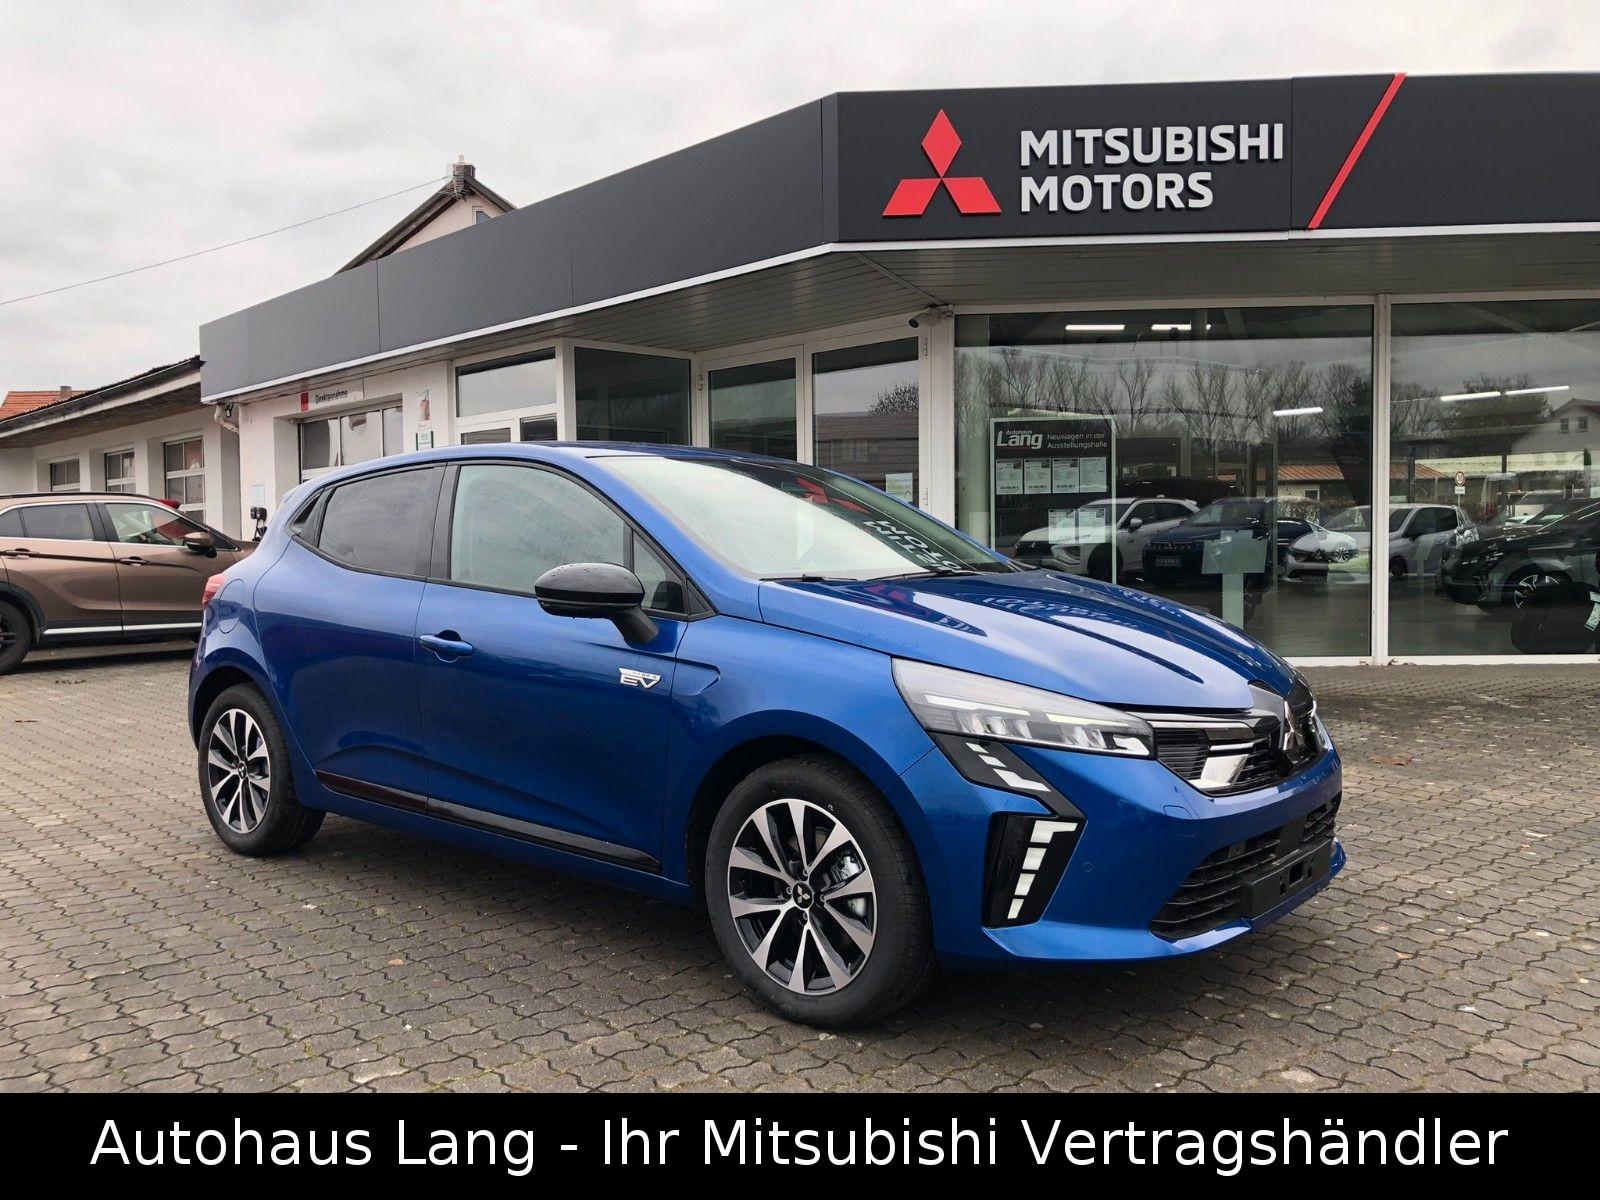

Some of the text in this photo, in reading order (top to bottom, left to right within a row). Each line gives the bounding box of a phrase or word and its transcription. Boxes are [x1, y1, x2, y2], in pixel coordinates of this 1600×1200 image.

[1020, 122, 1285, 167] MITSUBISHI
[1020, 171, 1214, 213] MOTORS
[996, 430, 1043, 449] Lang
[1047, 433, 1083, 441] Neuwagen
[1047, 441, 1108, 449] Ausstellungshalle
